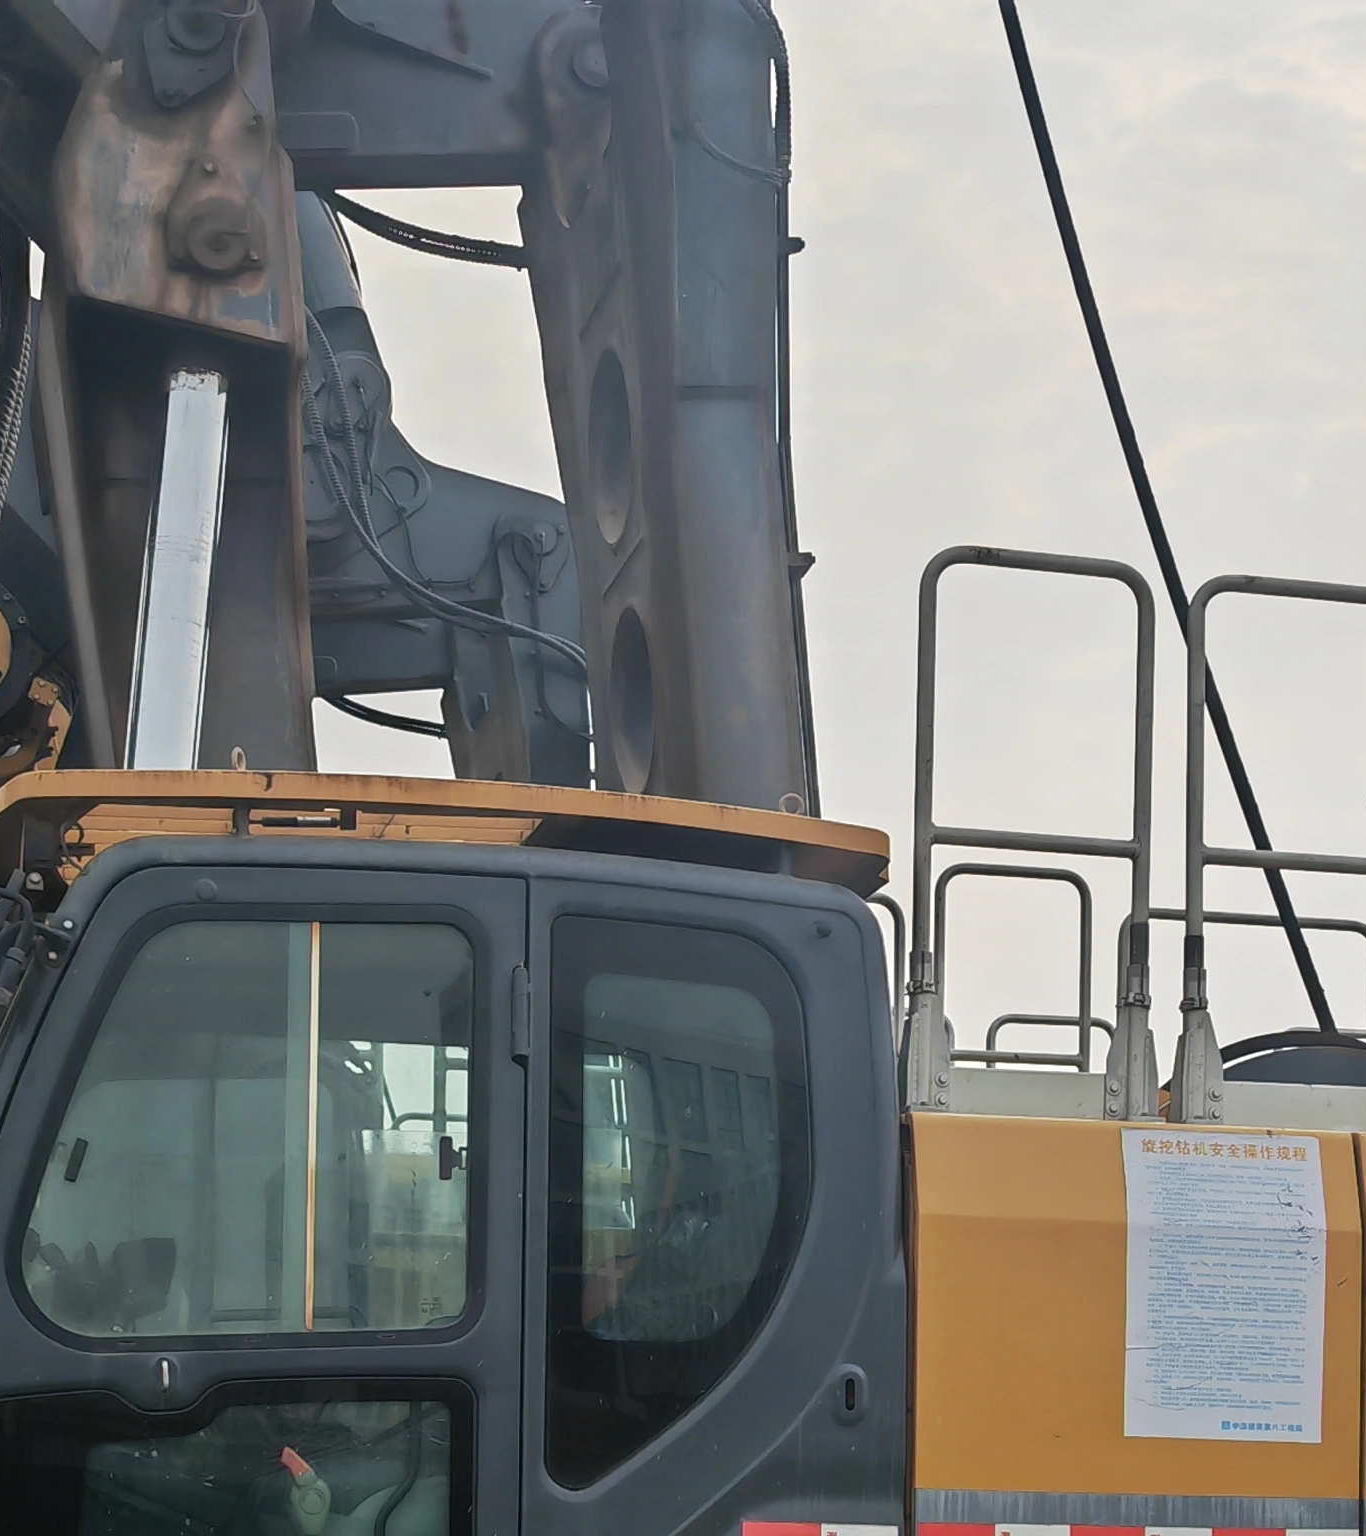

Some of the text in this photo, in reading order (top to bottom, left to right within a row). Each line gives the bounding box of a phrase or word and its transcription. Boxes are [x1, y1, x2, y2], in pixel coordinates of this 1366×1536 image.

[1141, 1138, 1308, 1162] 旋挖钻机安全操作规程
